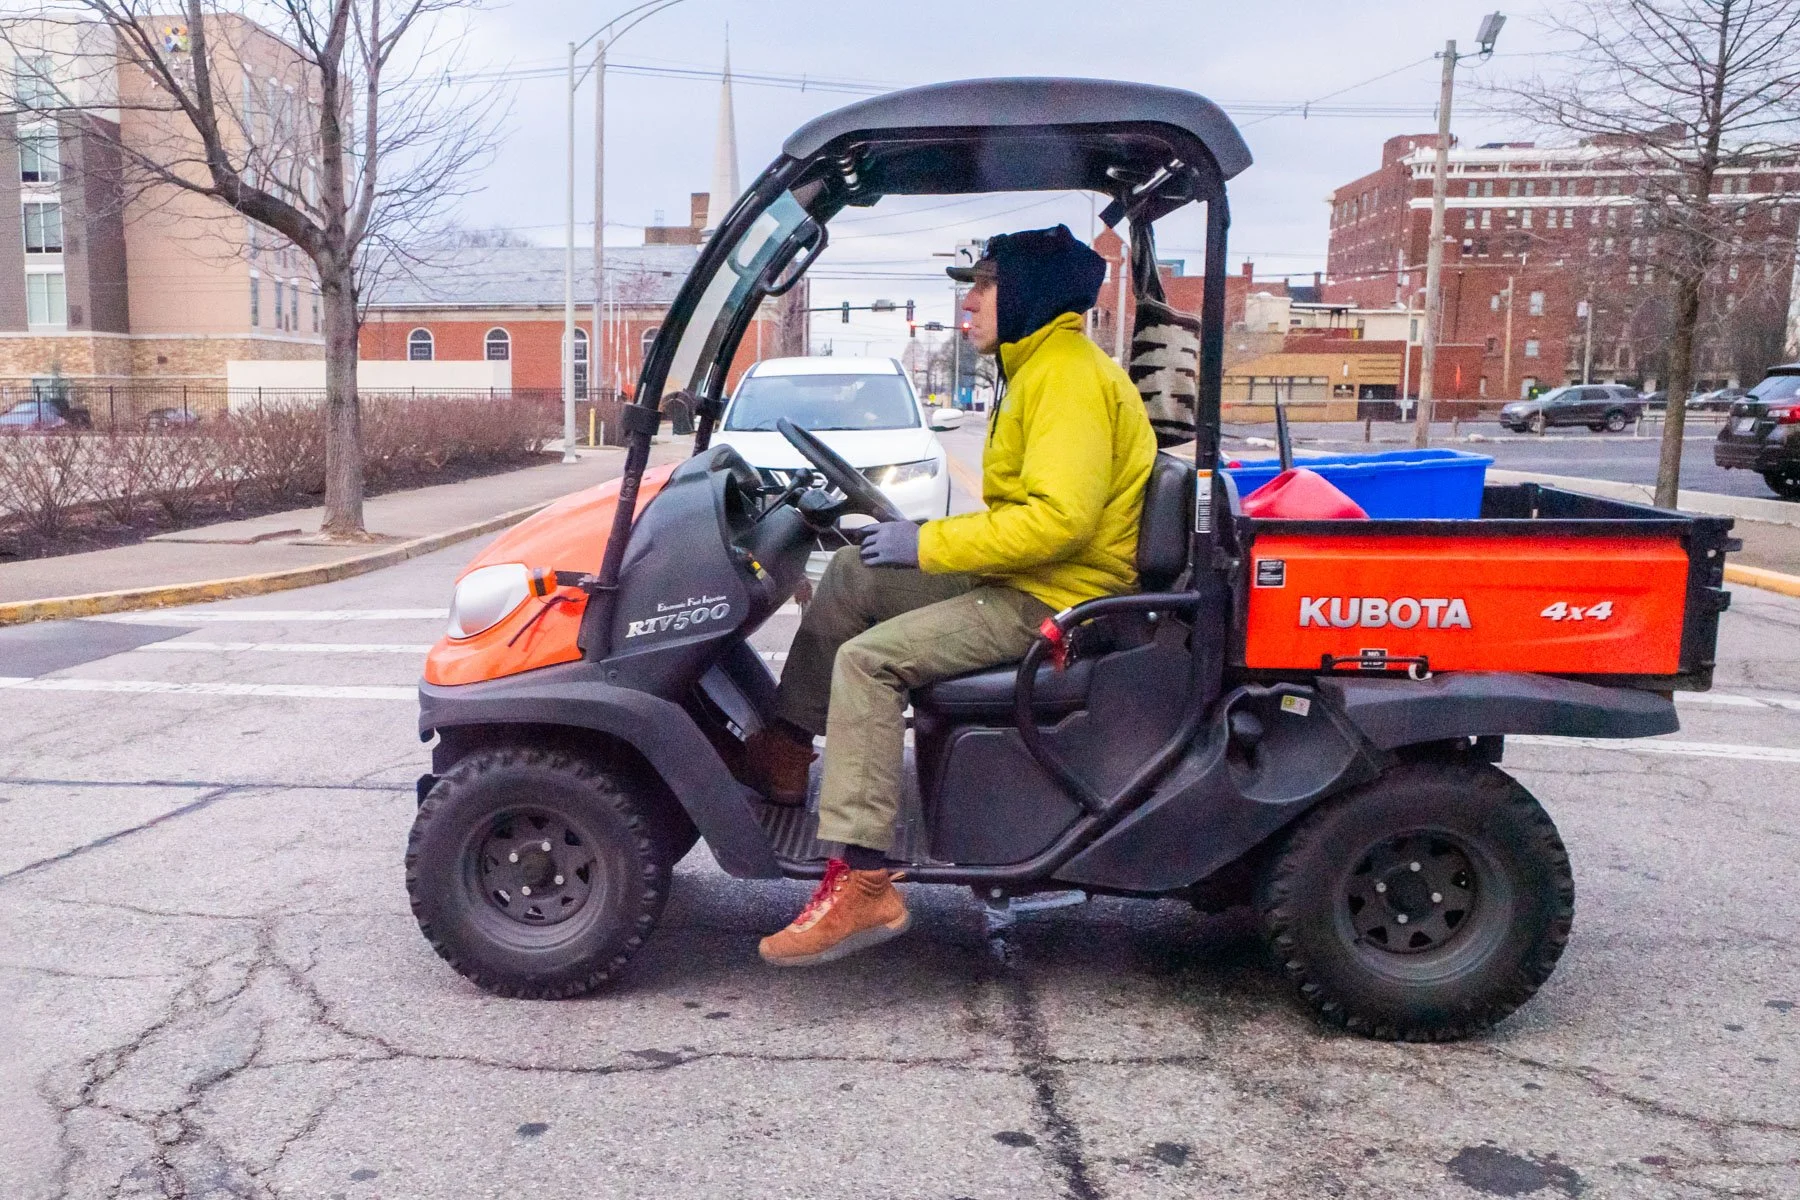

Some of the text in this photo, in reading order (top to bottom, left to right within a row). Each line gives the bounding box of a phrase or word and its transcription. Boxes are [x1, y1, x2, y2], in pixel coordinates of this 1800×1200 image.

[625, 602, 731, 638] RTV500
[1299, 597, 1473, 629] KUBOTA
[1540, 601, 1614, 621] 4x4
